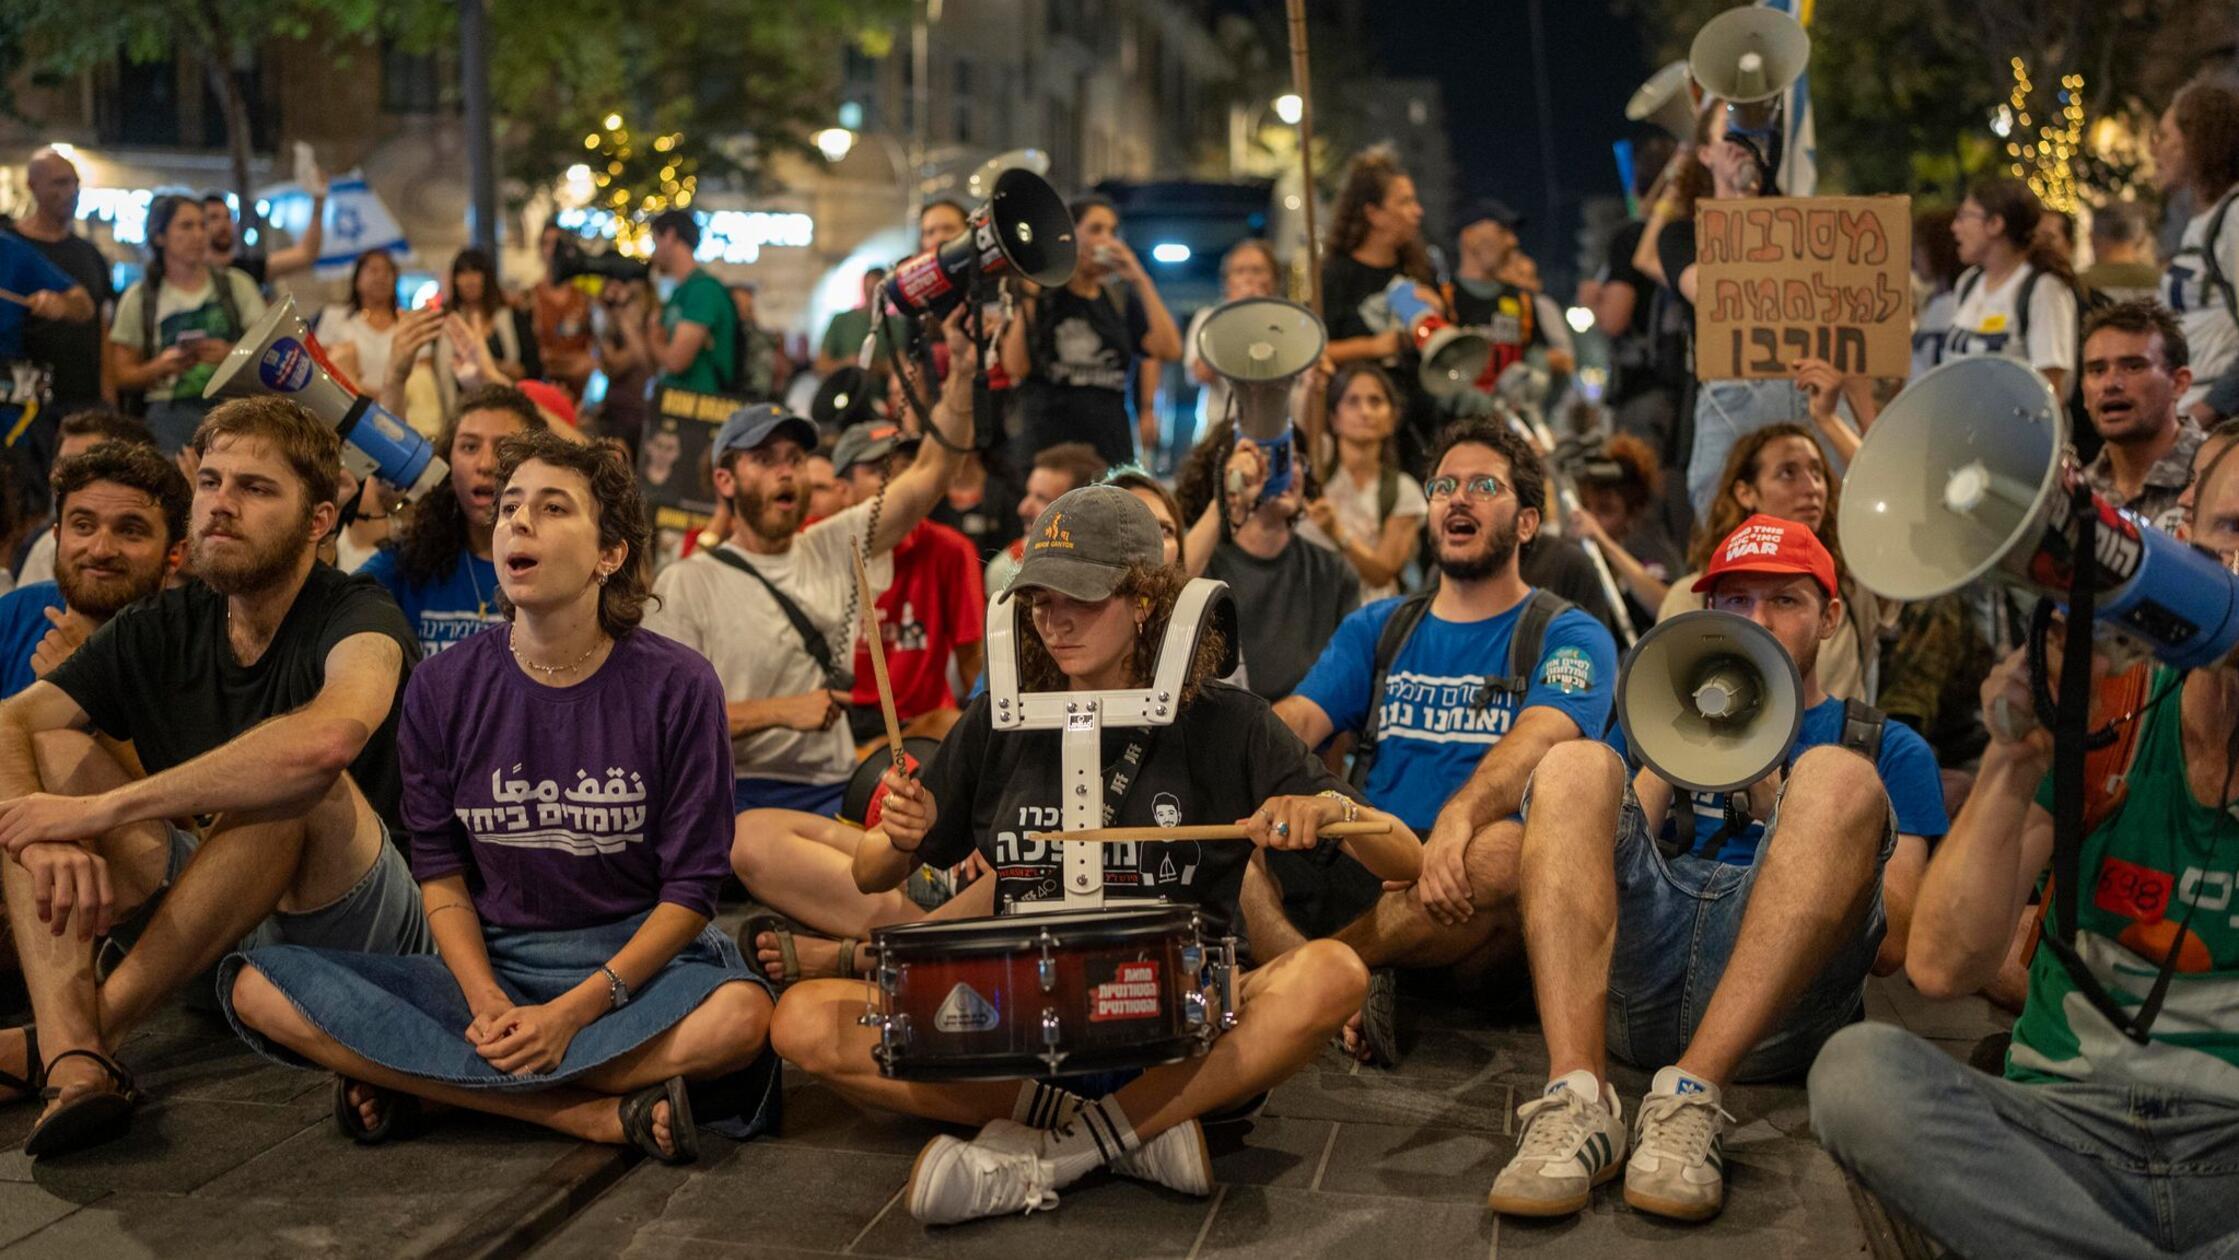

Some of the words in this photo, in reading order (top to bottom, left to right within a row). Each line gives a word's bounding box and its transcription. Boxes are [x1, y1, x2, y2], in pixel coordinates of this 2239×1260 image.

[1701, 207, 1889, 265] מסרבות
[1710, 271, 1901, 324] למלחמת
[1732, 325, 1866, 377] חורבן
[1753, 525, 1785, 535] THIS
[1726, 541, 1779, 562] WAR
[1422, 706, 1511, 733] ואנחנו
[492, 762, 560, 804] معًا
[564, 766, 647, 803] نقف
[455, 805, 530, 833] ביחד
[537, 802, 647, 833] עומדים
